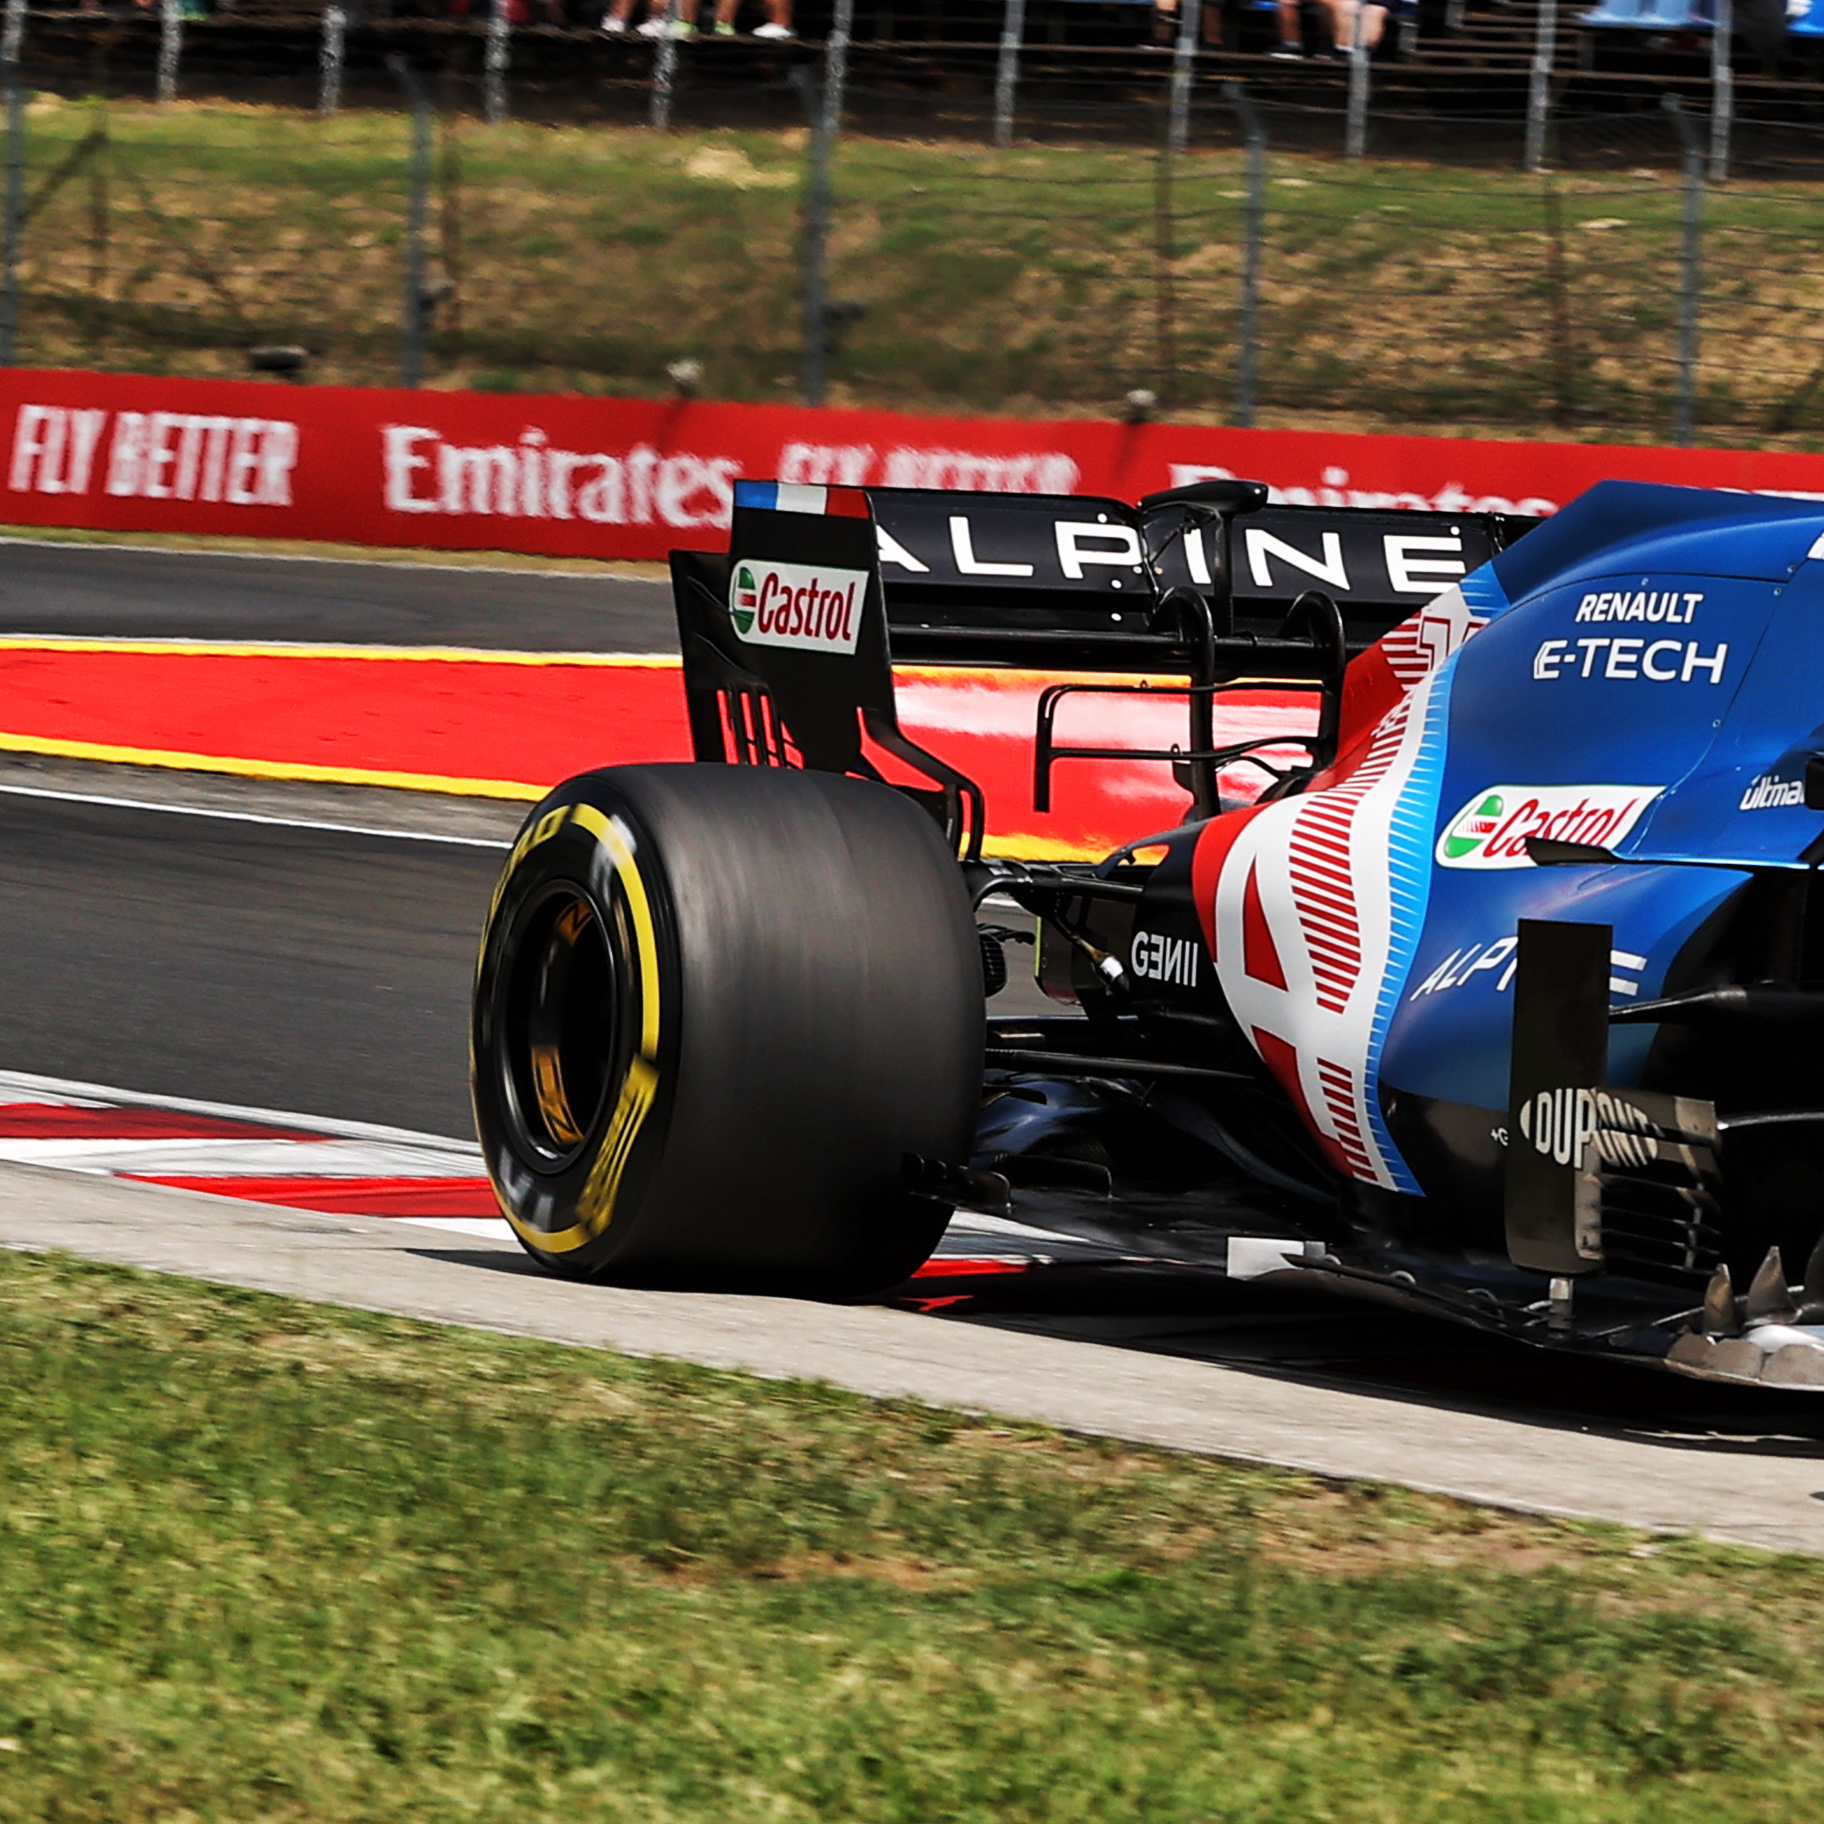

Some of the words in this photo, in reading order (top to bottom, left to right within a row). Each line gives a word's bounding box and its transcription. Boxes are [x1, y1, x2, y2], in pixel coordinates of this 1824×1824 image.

[8, 402, 106, 495] FLY
[103, 410, 300, 507] BETTER
[380, 423, 743, 530] Emirates
[757, 572, 856, 643] Castrol
[1575, 591, 1704, 625] RENAULT
[1533, 637, 1729, 685] E-TECH
[1482, 797, 1641, 859] Castrol
[1409, 935, 1648, 1002] ALPI
